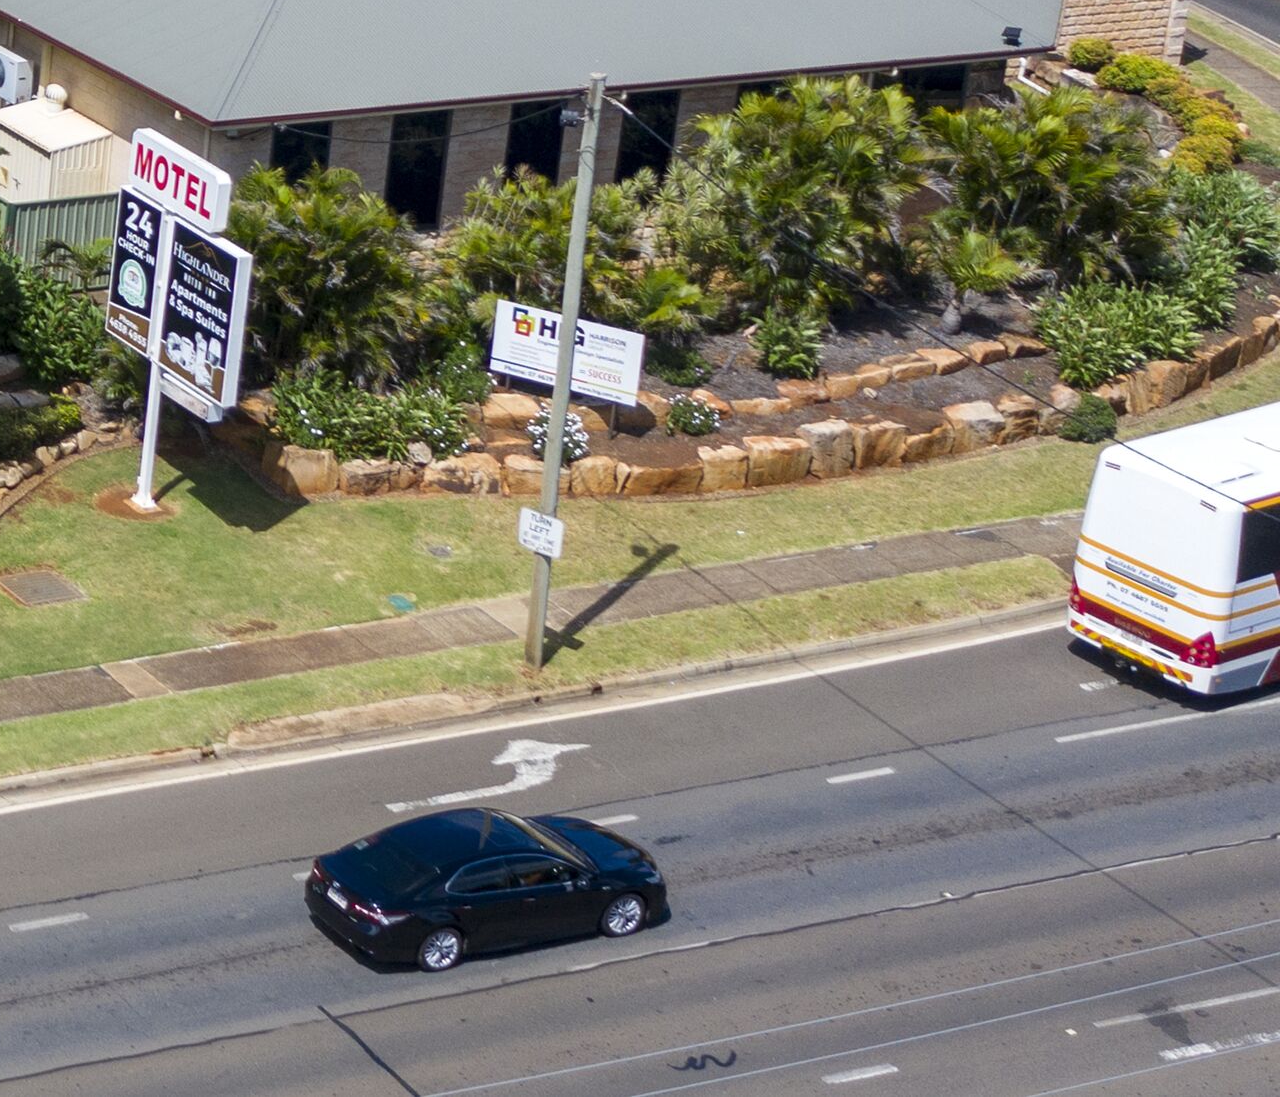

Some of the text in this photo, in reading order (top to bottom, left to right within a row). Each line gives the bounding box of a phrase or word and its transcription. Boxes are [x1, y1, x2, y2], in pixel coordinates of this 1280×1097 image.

[134, 142, 210, 220] MOTEL
[125, 202, 153, 239] 24
[118, 236, 155, 266] CHECK-IN
[126, 230, 149, 251] HOUR
[169, 294, 226, 339] & Spa Suites
[171, 279, 228, 323] Apartments
[539, 318, 585, 346] HG
[588, 368, 622, 384] SUCCESS
